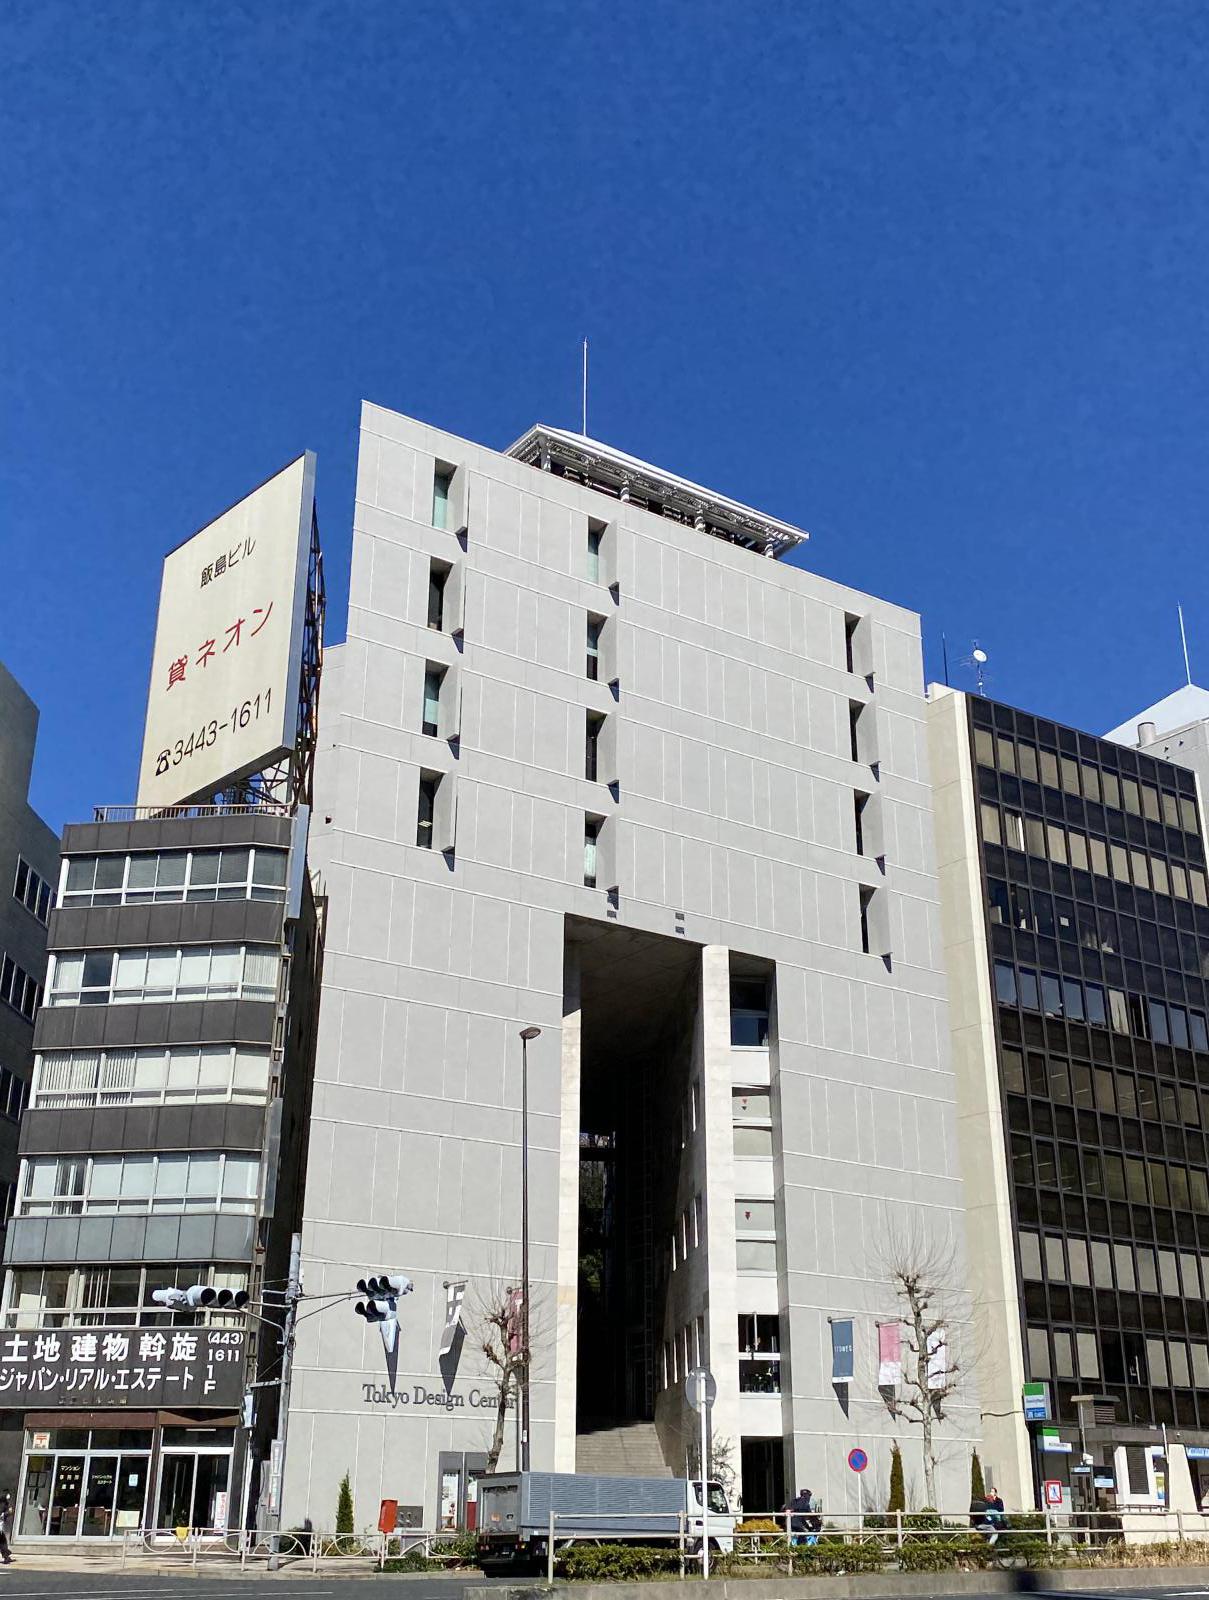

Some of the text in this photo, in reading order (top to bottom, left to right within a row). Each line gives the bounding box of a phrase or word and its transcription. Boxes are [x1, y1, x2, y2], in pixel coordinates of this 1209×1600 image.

[200, 536, 256, 588] 飯島ビル
[166, 601, 274, 691] 貸ネオン
[173, 687, 272, 766] 3443-1611
[207, 1331, 244, 1345] (443)
[208, 1349, 240, 1362] 1611
[362, 1383, 410, 1409] Tokyo
[413, 1386, 465, 1412] Design
